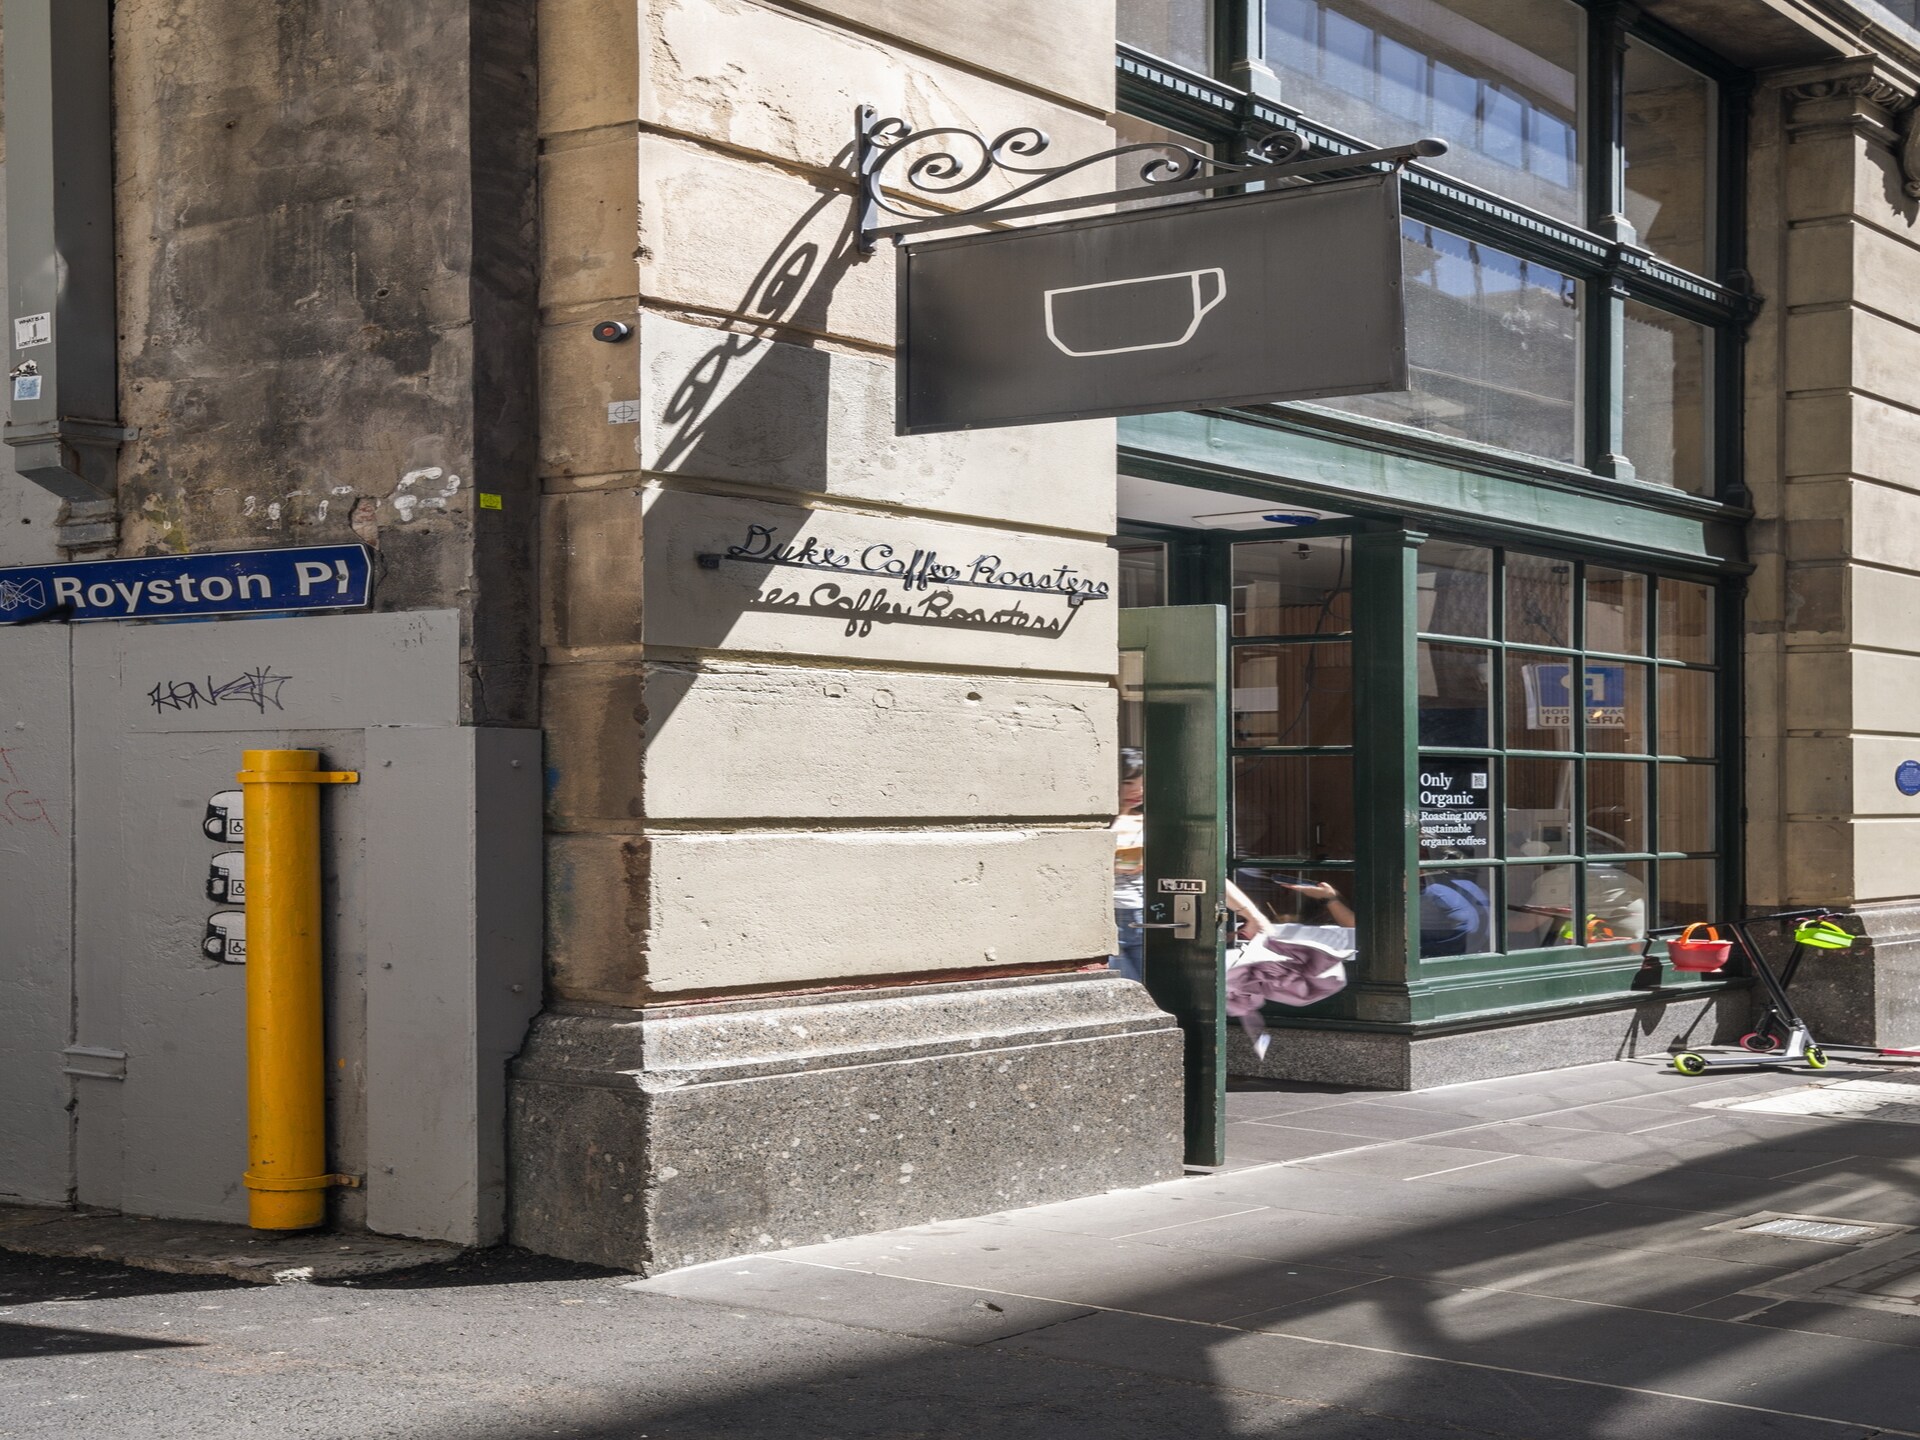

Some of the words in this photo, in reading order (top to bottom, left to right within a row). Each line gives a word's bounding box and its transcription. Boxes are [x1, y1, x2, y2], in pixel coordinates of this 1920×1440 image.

[727, 524, 850, 567] Dukes
[860, 544, 960, 591] Coffee
[966, 554, 1110, 594] Roasters
[54, 572, 272, 613] Royston
[295, 559, 350, 597] Pl
[1420, 772, 1453, 790] Only
[1420, 791, 1474, 808] Organic
[1421, 811, 1462, 823] Roasting
[1462, 811, 1487, 821] 100%
[1421, 823, 1472, 834] sustainable
[1421, 836, 1456, 848] organic
[1456, 835, 1487, 846] coffees
